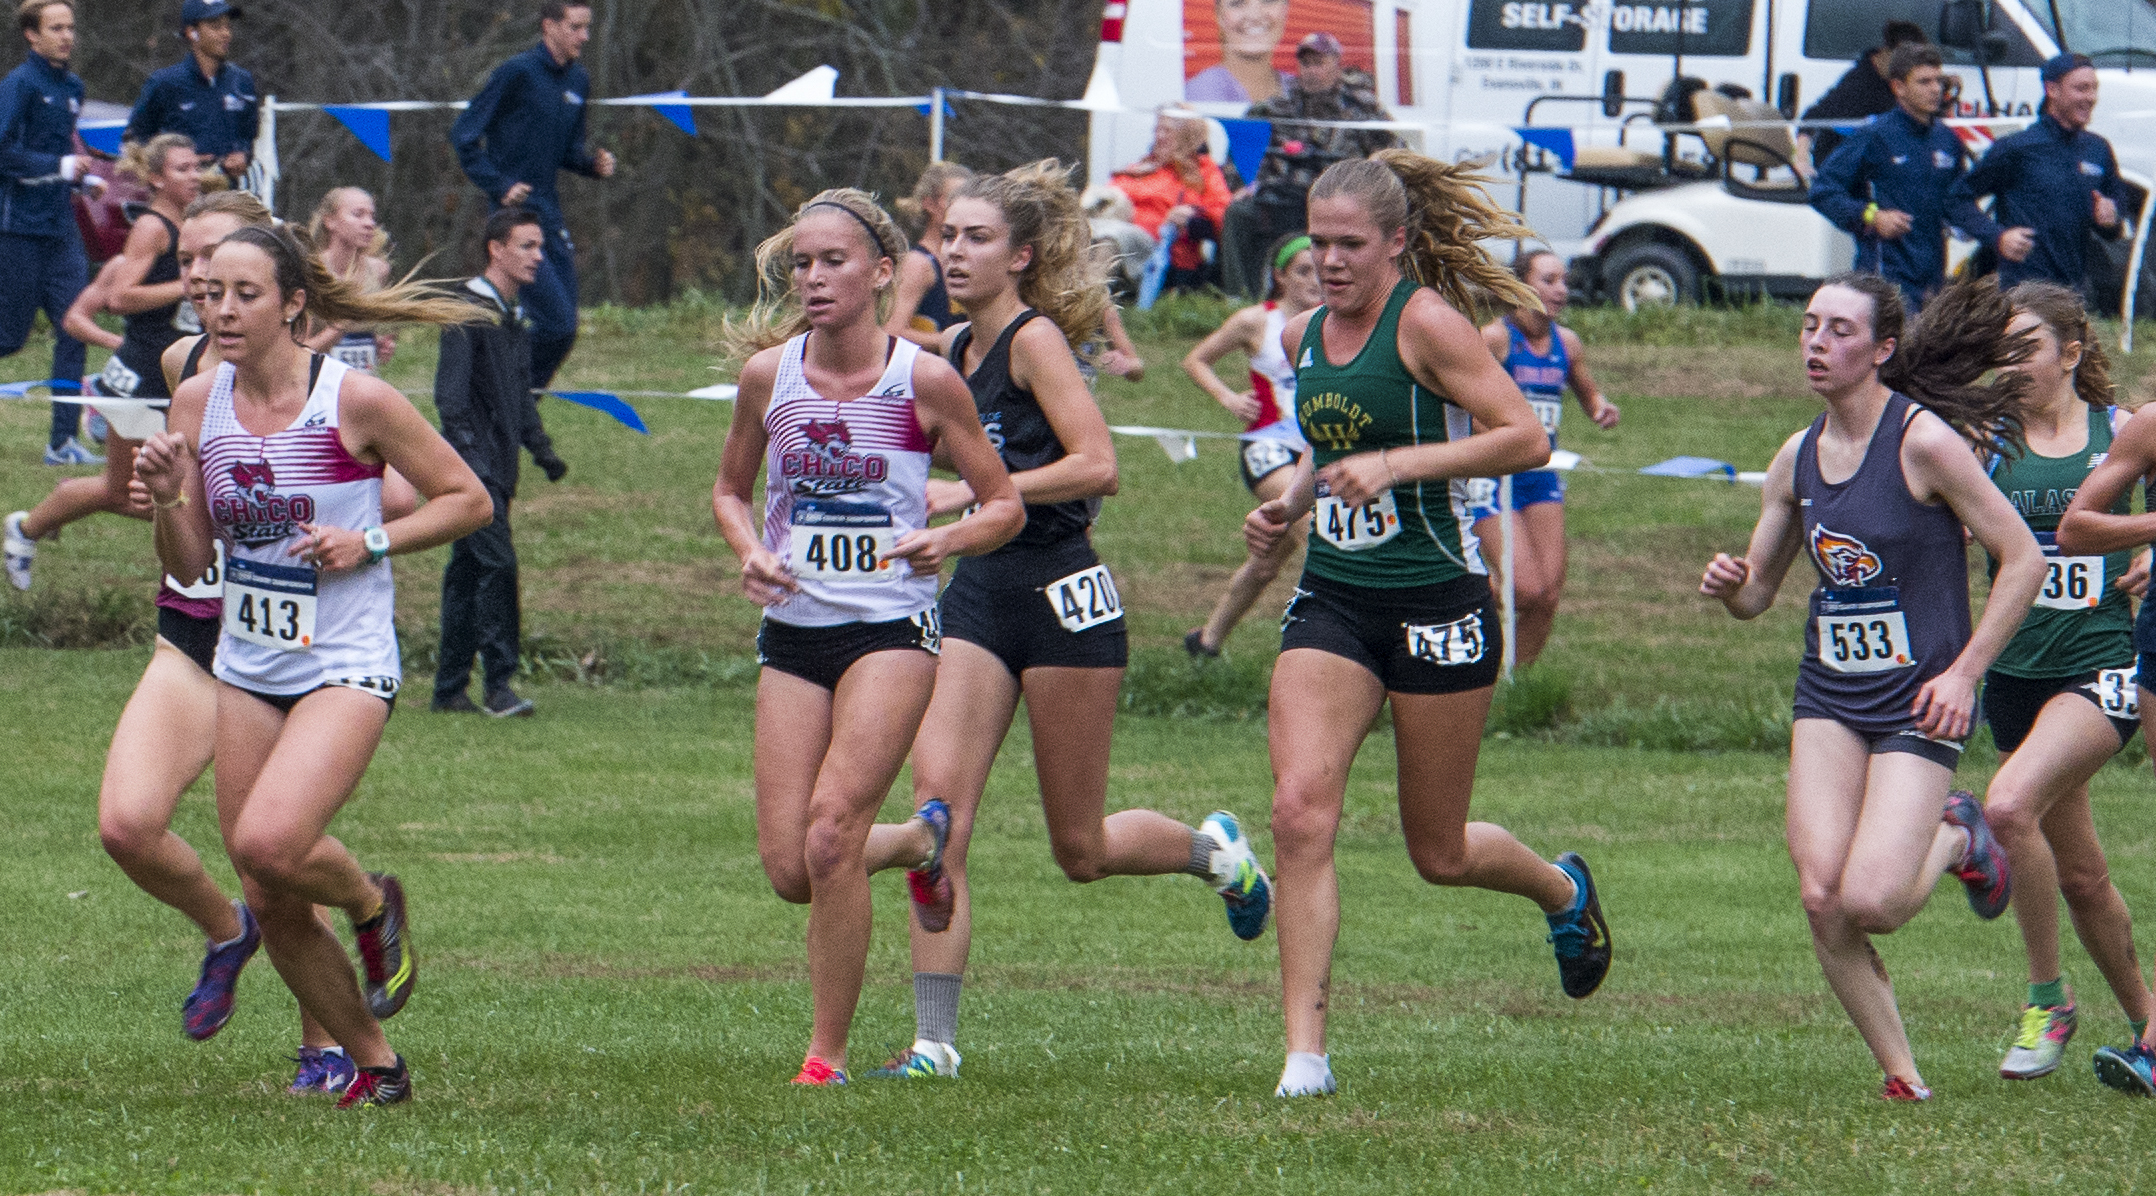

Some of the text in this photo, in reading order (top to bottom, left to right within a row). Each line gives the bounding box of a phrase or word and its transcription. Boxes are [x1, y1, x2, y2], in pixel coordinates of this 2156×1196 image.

[1500, 2, 1709, 34] SELF-SORAGE
[780, 451, 887, 483] CHICO
[212, 494, 315, 526] CHICO
[1328, 498, 1386, 541] 475
[2009, 487, 2079, 515] ALAS
[806, 534, 877, 573] 408
[1059, 571, 1117, 624] 420
[2043, 562, 2089, 600] 36
[238, 593, 300, 641] 413
[1416, 618, 1480, 662] 475
[1831, 620, 1895, 662] 533
